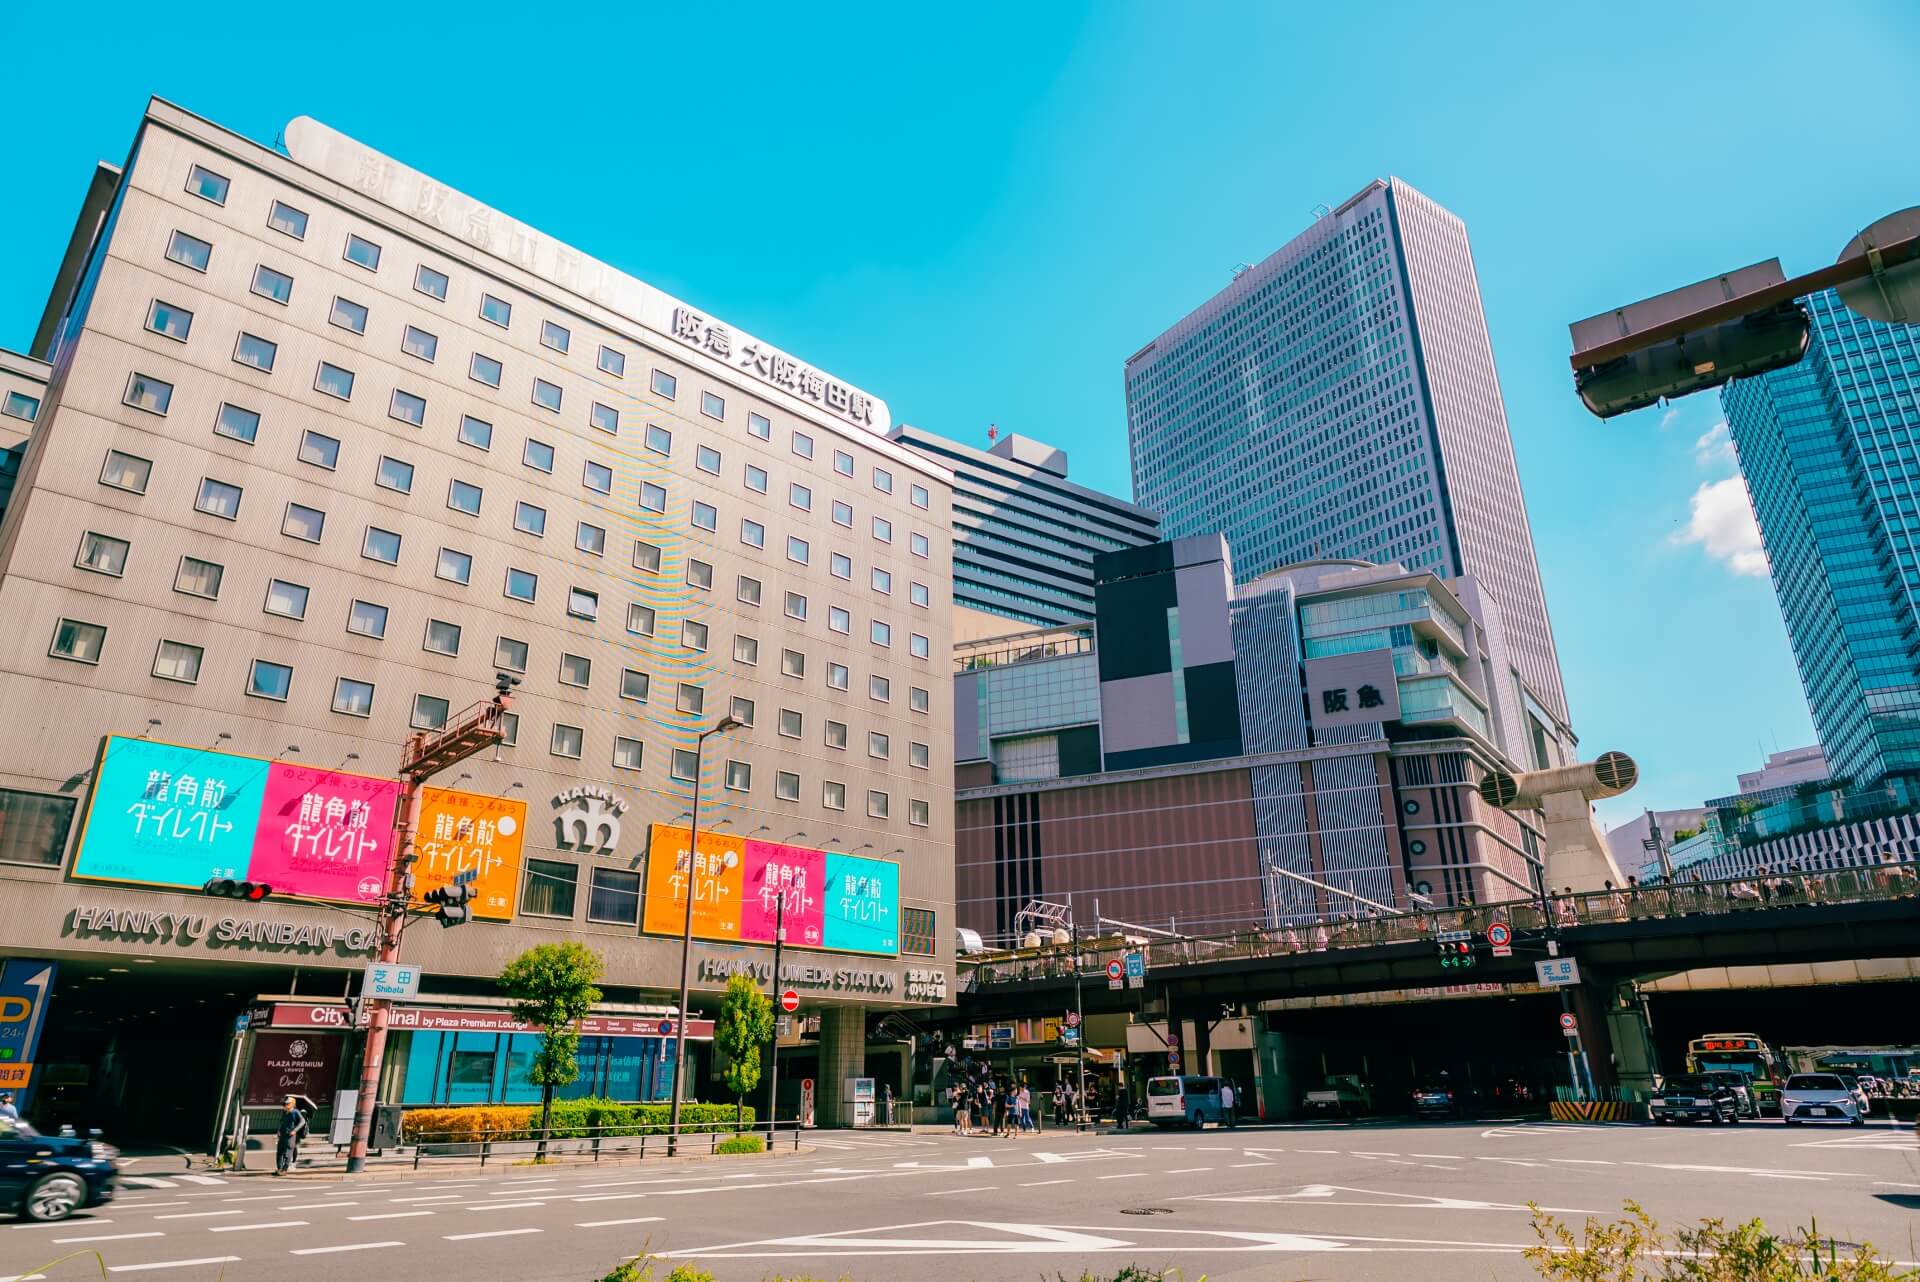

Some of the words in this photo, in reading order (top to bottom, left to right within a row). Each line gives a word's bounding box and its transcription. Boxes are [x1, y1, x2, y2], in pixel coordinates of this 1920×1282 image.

[672, 306, 732, 358] 阪急
[742, 344, 875, 425] 大阪梅田駅
[1322, 684, 1385, 714] 阪急
[145, 768, 228, 811] 龍角散
[558, 784, 629, 812] HANKYU
[127, 802, 233, 845] ダイレクト
[300, 792, 372, 829] 龍角散
[285, 823, 378, 864] ダイレクト
[434, 813, 497, 847] 龍角散
[422, 841, 504, 879] ダイレクト
[764, 862, 808, 889] 龍角散
[843, 874, 882, 899] 龍角散
[839, 897, 889, 922] ダイレクト
[72, 905, 208, 939] HANKYU
[215, 917, 382, 950] SANBAN-GA
[372, 967, 412, 984] 芝田
[704, 959, 776, 980] HANKYU
[780, 963, 833, 985] UMEDA
[837, 967, 897, 989] STATION
[1542, 962, 1571, 976] 芝田
[375, 984, 404, 994] Shibata
[311, 1007, 345, 1026] City
[422, 1017, 434, 1028] by
[435, 1017, 459, 1027] Plaza
[460, 1018, 496, 1029] Premium
[498, 1020, 528, 1031] Lounge
[267, 1060, 290, 1068] PLAZA
